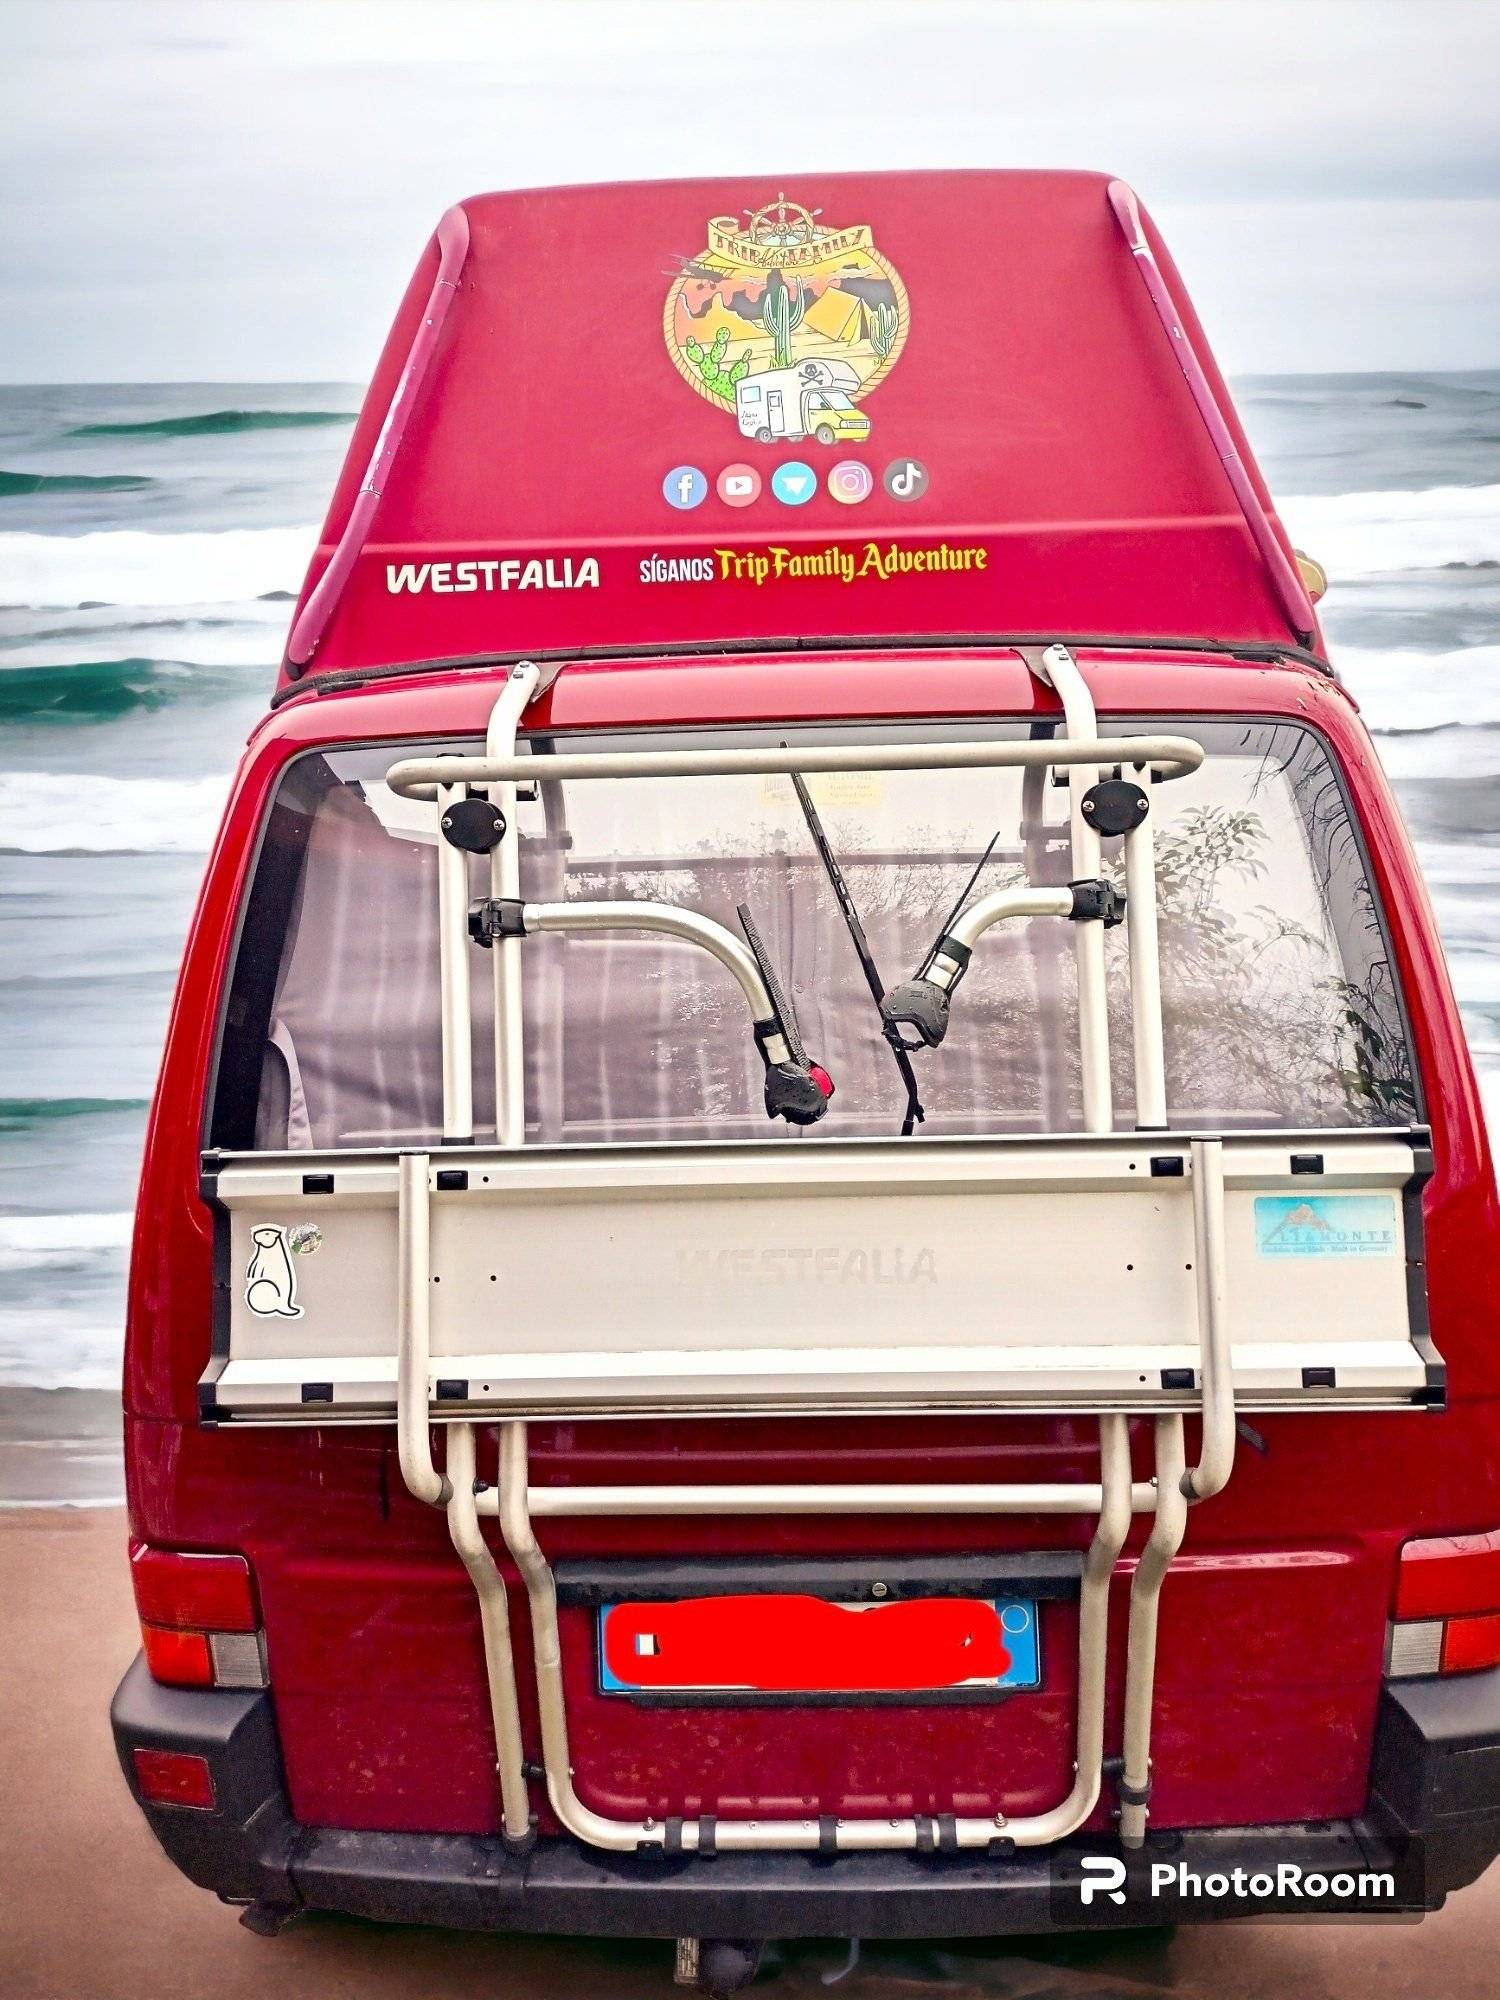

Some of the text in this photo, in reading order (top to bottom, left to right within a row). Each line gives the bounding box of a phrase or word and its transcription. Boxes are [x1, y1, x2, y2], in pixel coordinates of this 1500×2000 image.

[714, 228, 865, 262] TRIP FAMILY
[386, 557, 600, 594] WESTFALIA
[639, 542, 988, 586] SÍGANOS Trip Family Adventure
[674, 1247, 939, 1286] WESTFALIA
